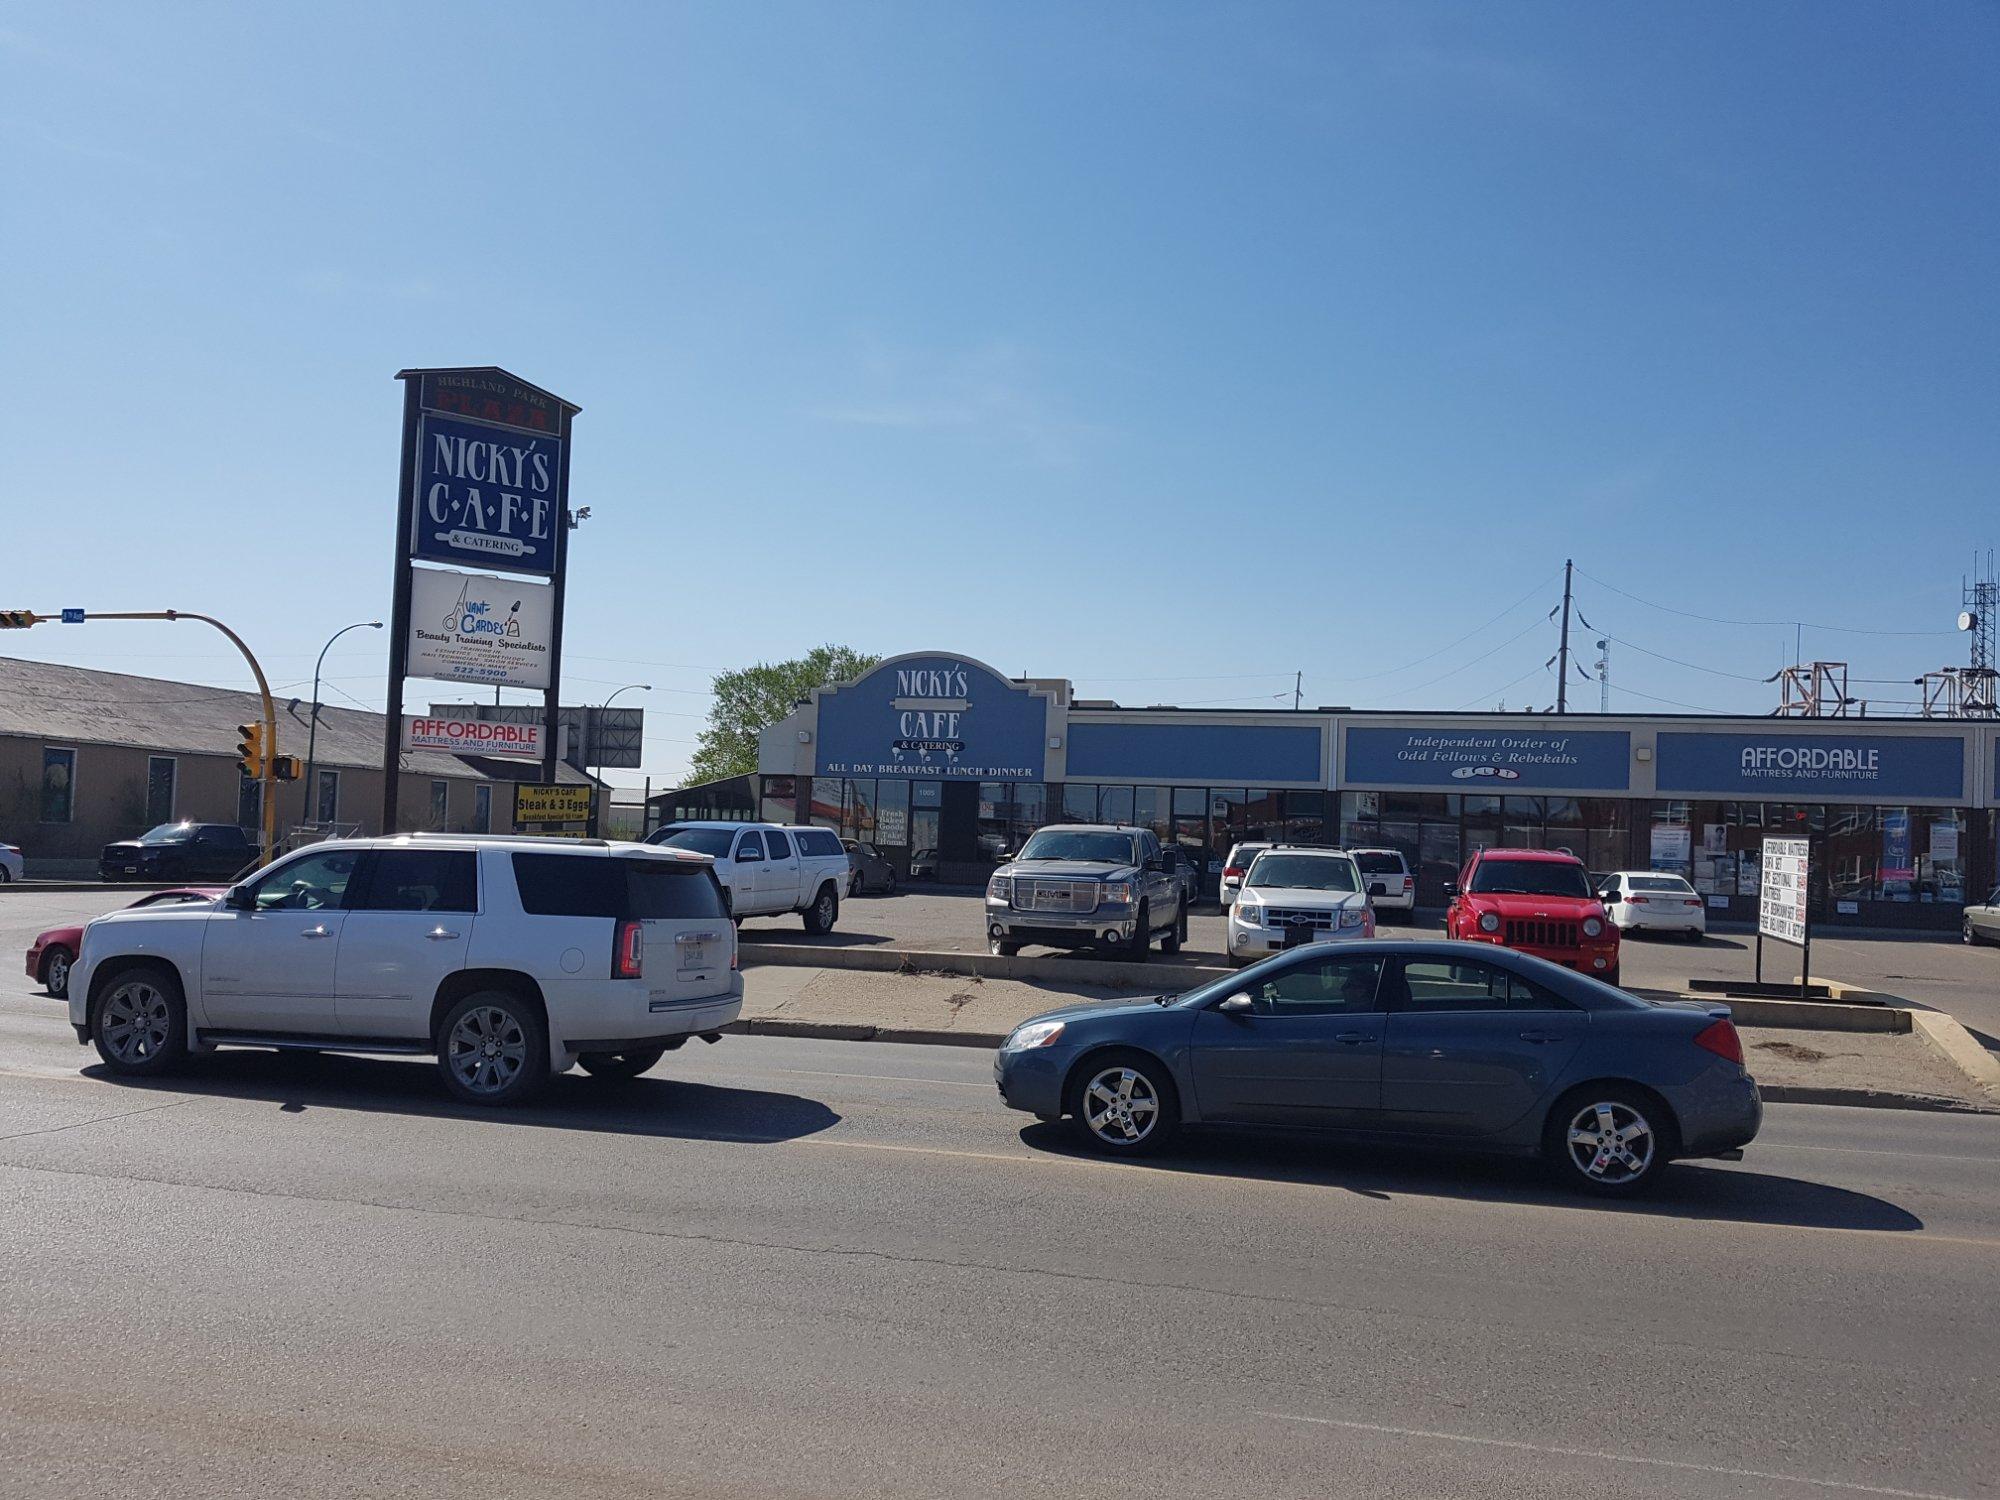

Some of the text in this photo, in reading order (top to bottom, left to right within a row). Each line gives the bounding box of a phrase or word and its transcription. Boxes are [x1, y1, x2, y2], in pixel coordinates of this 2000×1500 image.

[438, 376, 548, 408] HIGHLAND PARK
[433, 433, 549, 493] NICKY'S
[452, 534, 519, 552] & CATERING
[416, 629, 546, 652] Beauty Training Specialists
[453, 666, 508, 677] 522-5900
[896, 663, 968, 698] NICKY'S
[411, 718, 537, 744] AFFORDABLE
[900, 712, 960, 739] CAFE
[411, 735, 537, 751] MATTRESS AND FURNITURE
[901, 741, 960, 751] & CATERING
[1407, 736, 1569, 751] Independent Order of
[1397, 750, 1578, 765] Odd Fellows & Rebekahs
[1741, 747, 1879, 771] AFFORDABLE
[827, 763, 1033, 777] ALL DAY BREAKFAST LUNCH DINNER
[1741, 769, 1879, 780] MATTRESS AND FURNITURE
[533, 788, 577, 796] NICKY'S CAFE
[518, 798, 589, 811] Steak & 3 Eggs
[879, 816, 904, 824] Baked
[881, 809, 904, 817] Fresh
